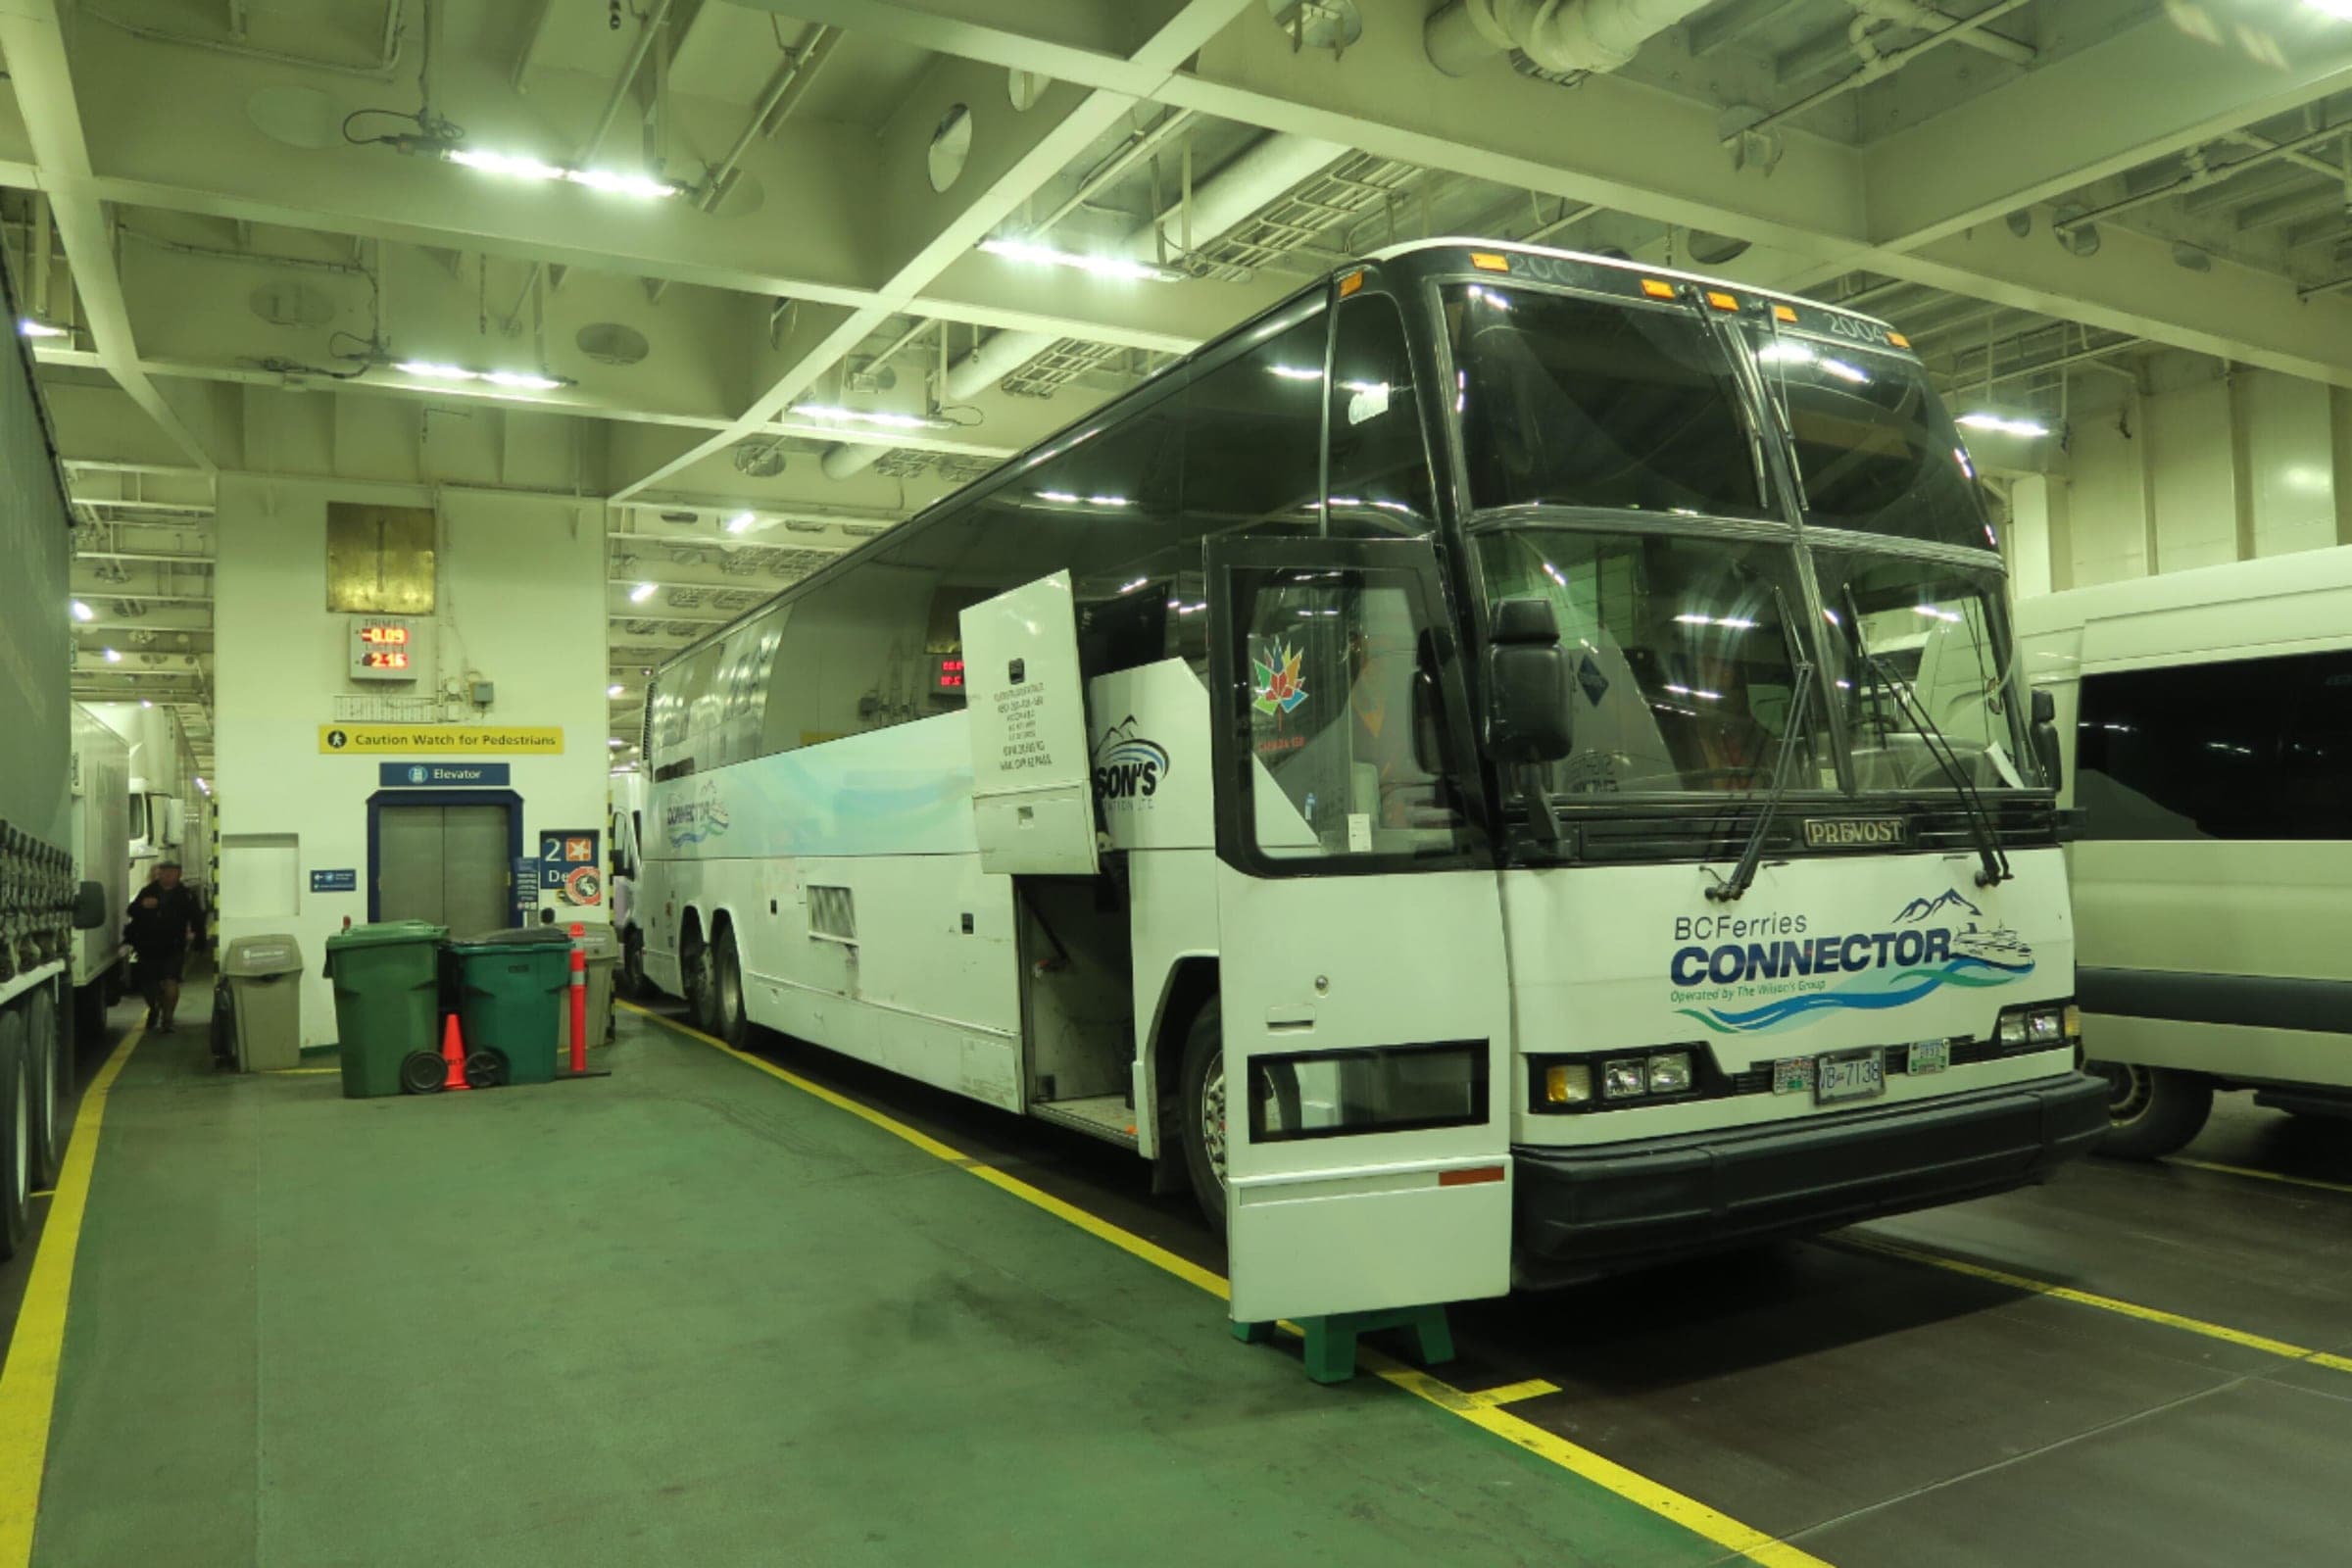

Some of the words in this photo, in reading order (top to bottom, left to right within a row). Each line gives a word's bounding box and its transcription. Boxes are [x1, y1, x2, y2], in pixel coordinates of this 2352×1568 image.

[355, 734, 409, 746] Caution
[412, 734, 455, 746] Watch
[459, 734, 479, 746] for
[482, 734, 557, 746] Pedestrians
[433, 768, 482, 780] Elevator
[1810, 821, 1902, 844] PREVOST
[545, 838, 562, 861] 2
[1670, 927, 1952, 987] CONNECTOR
[1670, 988, 1719, 1004] Operated
[1722, 987, 1734, 1001] by
[1738, 985, 1754, 997] The
[1757, 982, 1795, 995] Wilson's
[1798, 980, 1826, 992] Group
